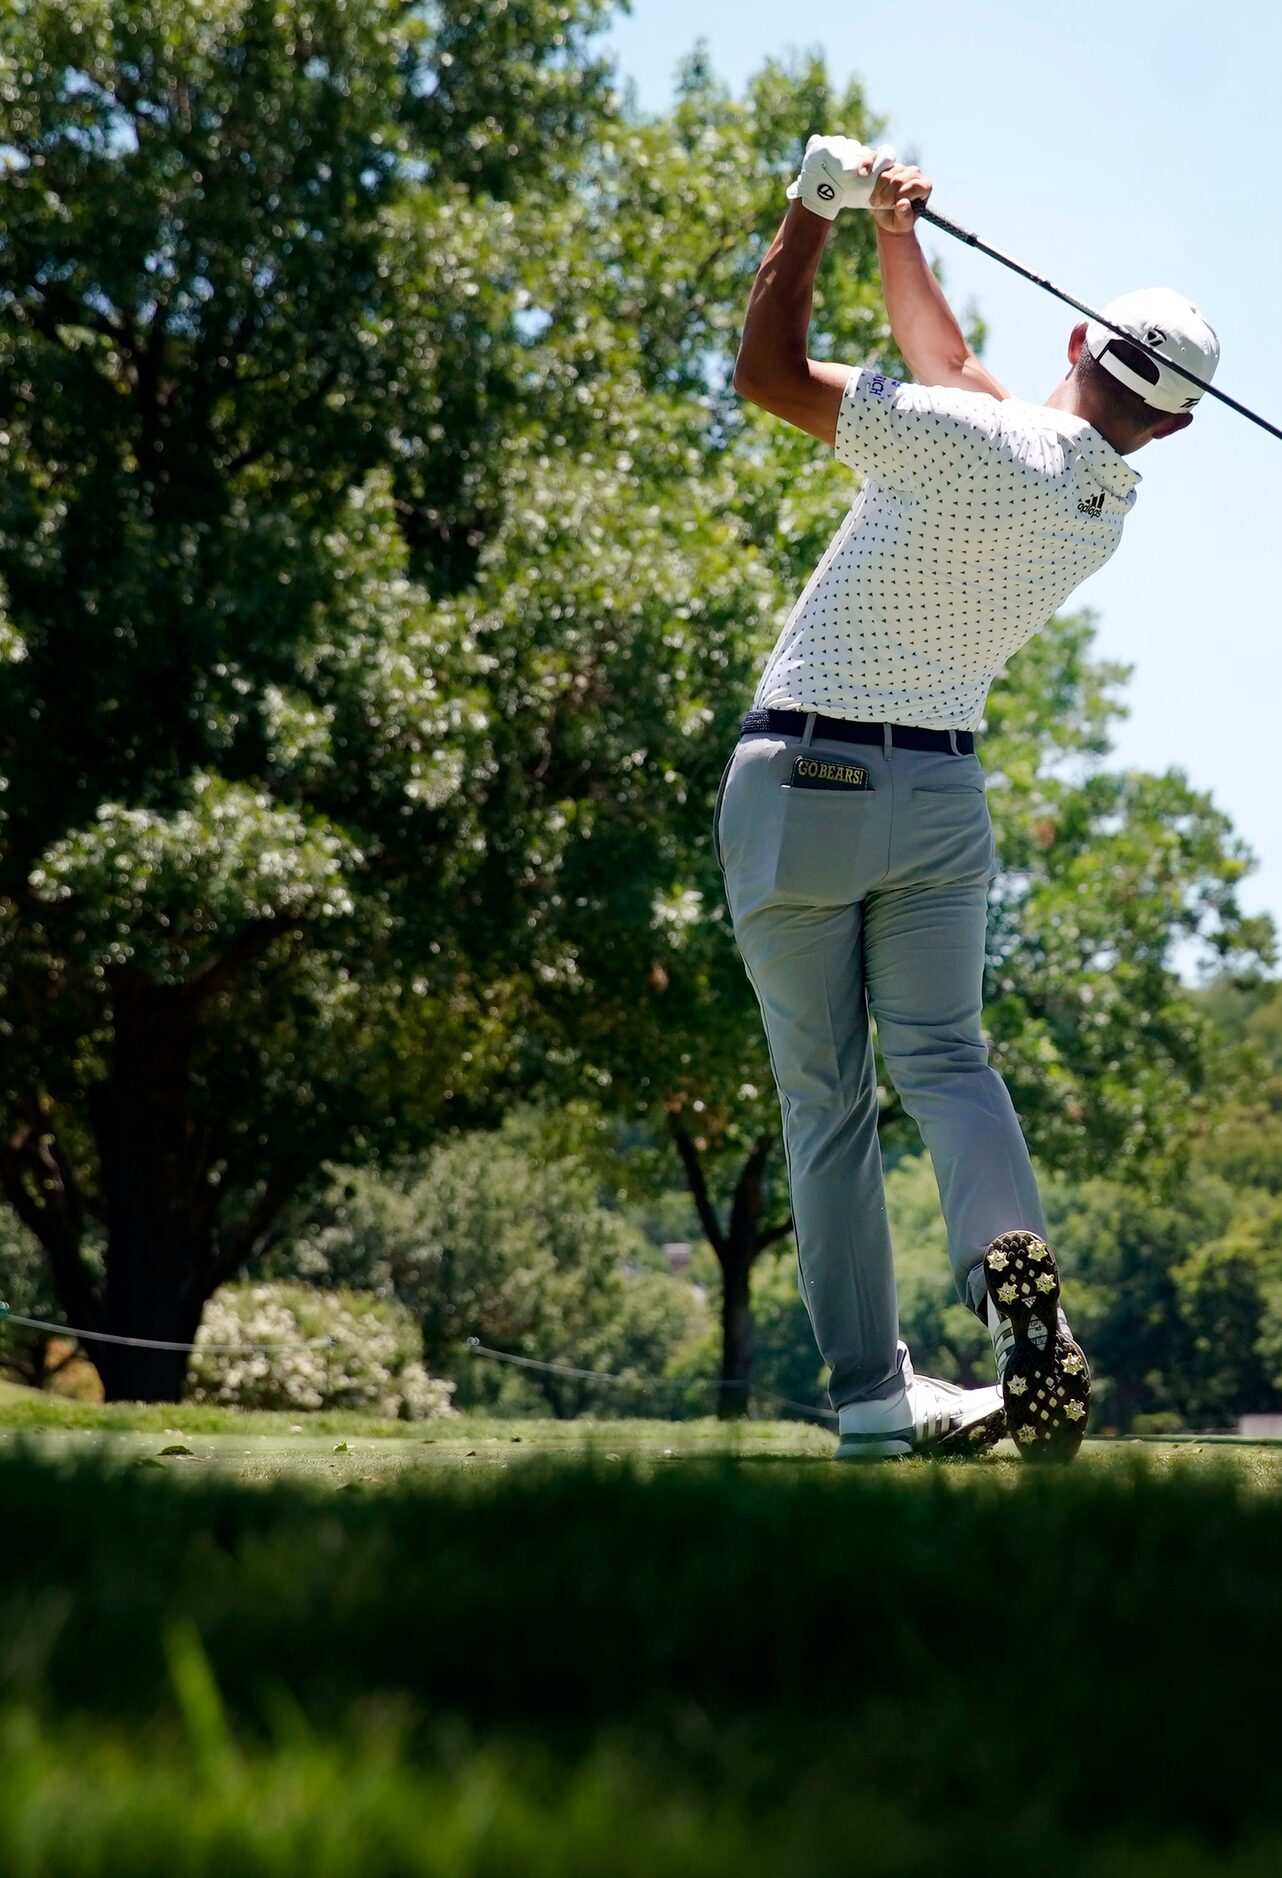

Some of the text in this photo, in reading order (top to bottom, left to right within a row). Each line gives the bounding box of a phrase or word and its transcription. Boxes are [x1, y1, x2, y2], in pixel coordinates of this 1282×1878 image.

[1077, 502, 1101, 518] adidas
[798, 761, 864, 785] GO BEARS!
